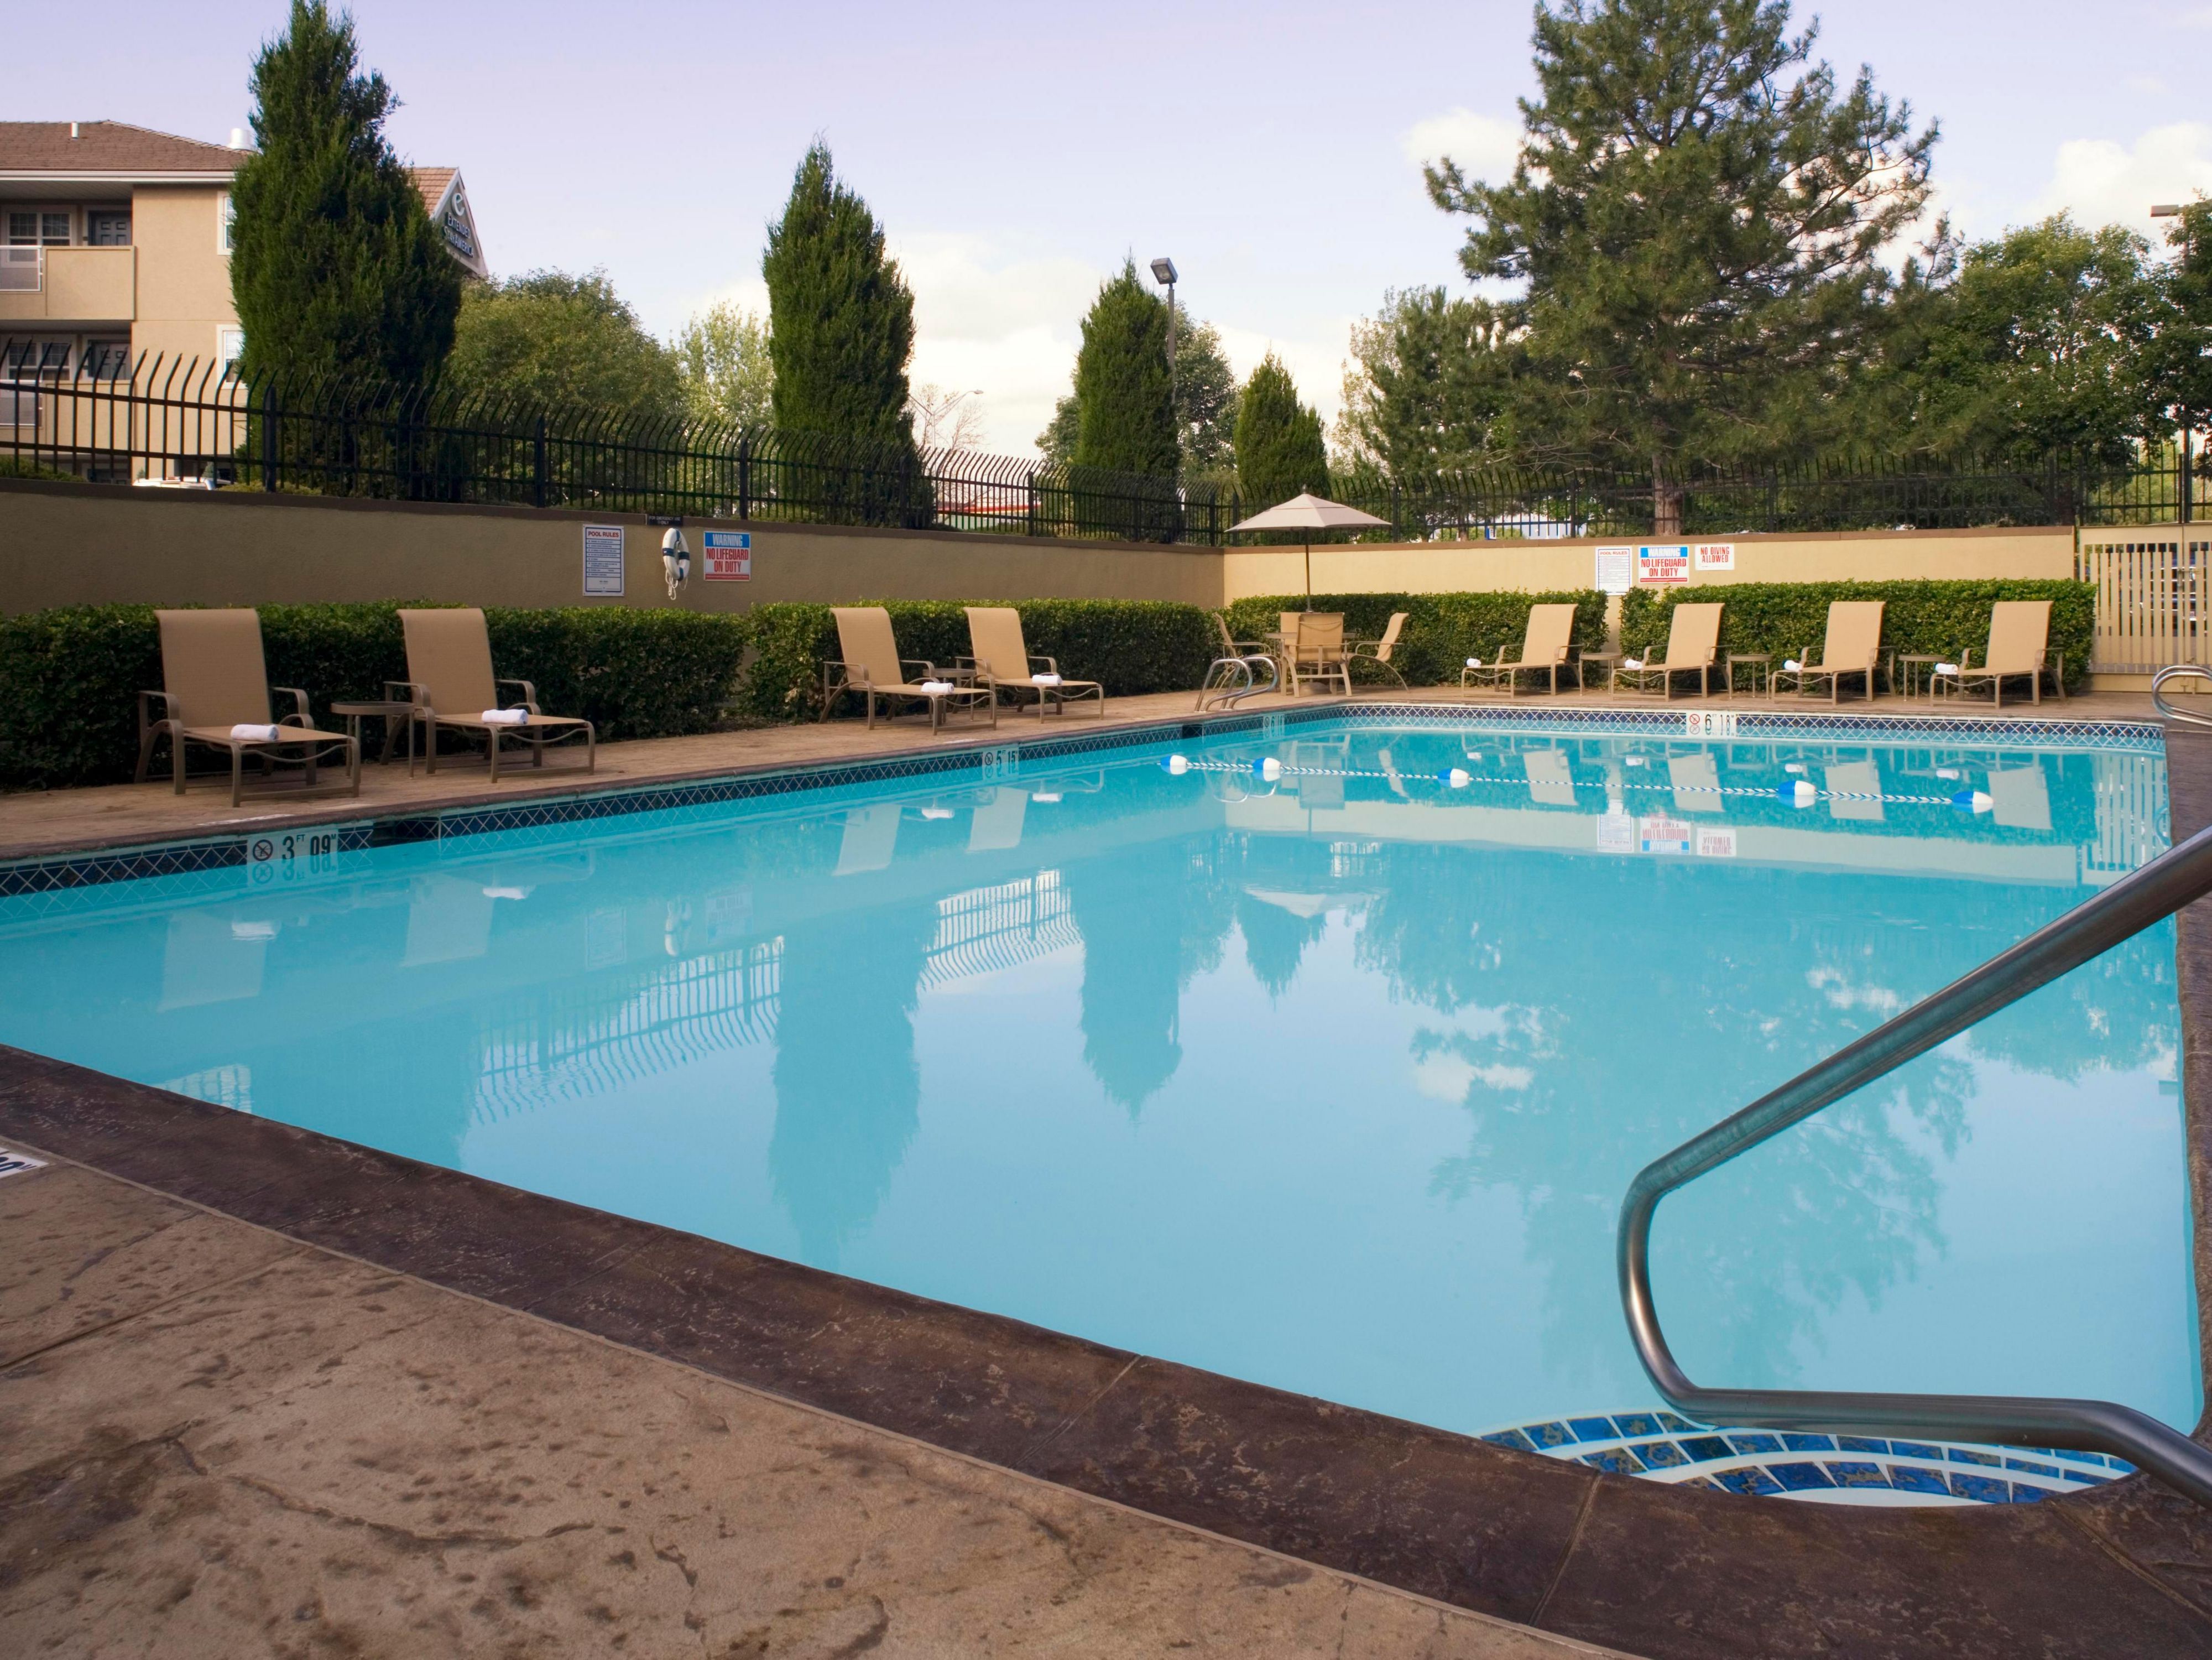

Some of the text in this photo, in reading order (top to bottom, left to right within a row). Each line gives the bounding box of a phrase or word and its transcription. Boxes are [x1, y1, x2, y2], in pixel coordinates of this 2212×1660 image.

[448, 212, 471, 239] EXTENDED
[713, 534, 743, 547] WARNING
[706, 548, 749, 560] NO LIFEGUARD
[1710, 547, 1729, 555] DIVING
[1641, 558, 1686, 567] NO LIFEGUARD
[1702, 555, 1729, 563] ALLOWED
[714, 560, 741, 573] ON DUTY
[1649, 568, 1678, 576] ON DUTY
[996, 750, 1002, 765] 5
[282, 836, 294, 860] 3
